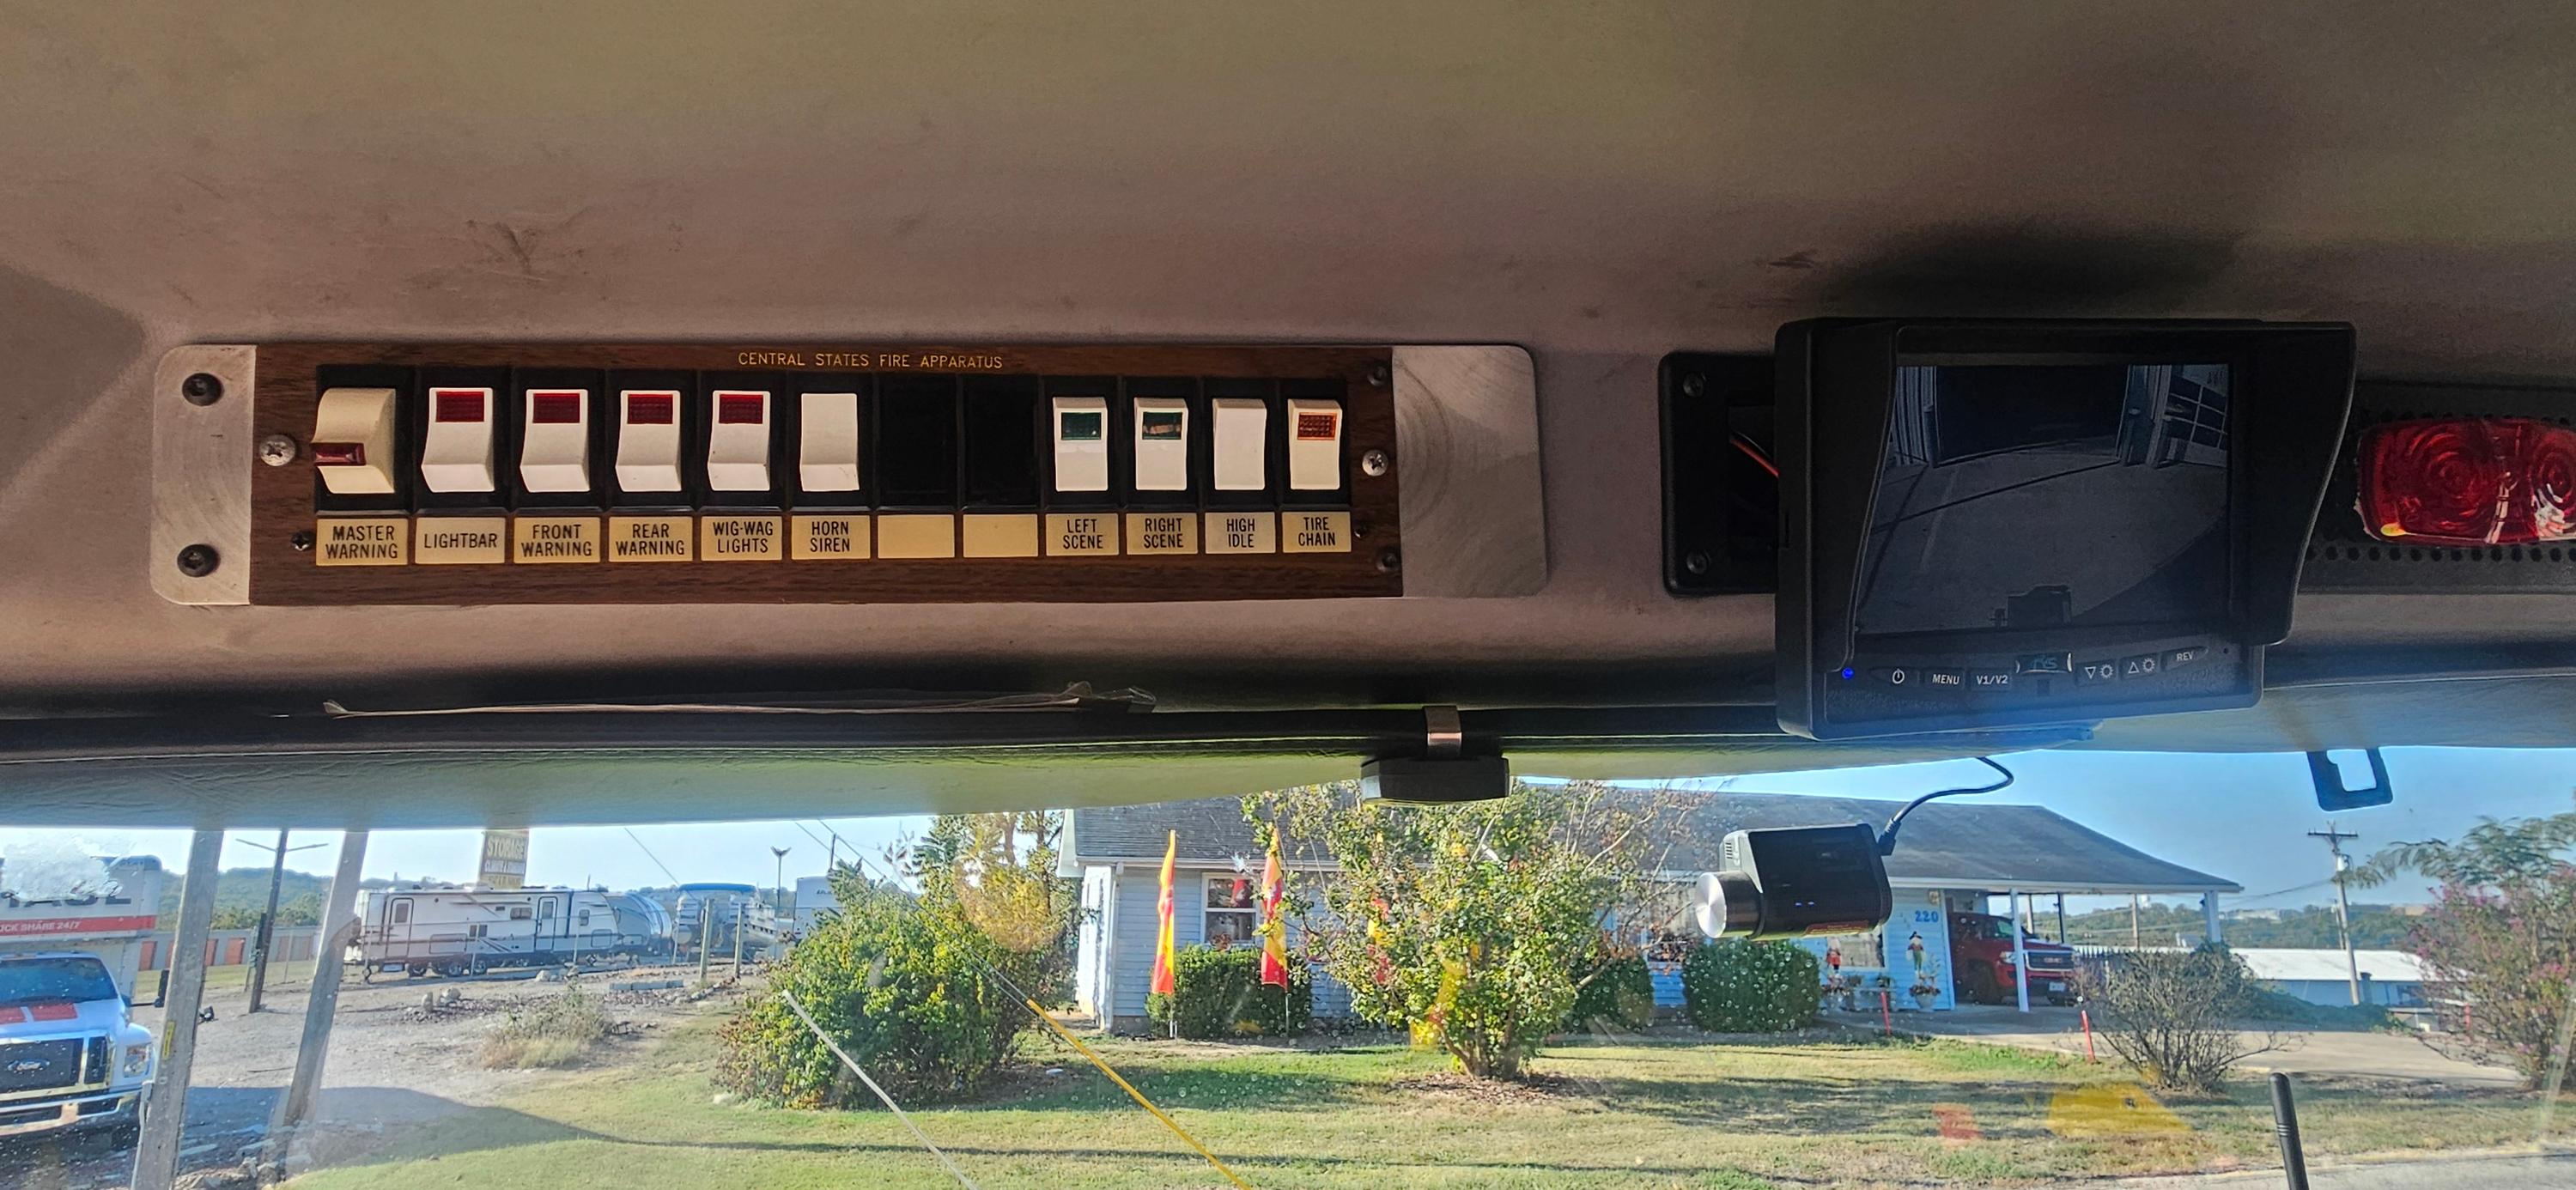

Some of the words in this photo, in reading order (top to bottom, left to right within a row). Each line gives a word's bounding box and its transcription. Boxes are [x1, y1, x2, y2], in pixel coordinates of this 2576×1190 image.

[738, 352, 805, 366] CENTRAL
[816, 354, 869, 367] STATES
[879, 355, 910, 367] FIRE
[920, 355, 1003, 369] APPARATUS
[632, 523, 670, 538] REAR
[713, 521, 774, 537] WIG-WAG
[811, 521, 849, 536] HORN
[1066, 519, 1097, 534] LEFT
[1145, 518, 1182, 532] RIGHT
[1226, 518, 1255, 532] HIGH
[1303, 517, 1330, 531] TIRE
[332, 525, 394, 542] MASTER
[532, 524, 581, 540] FRONT
[1297, 531, 1336, 547] CHAIN
[423, 533, 498, 549] LIGHTBAR
[616, 540, 685, 556] WARNING
[717, 537, 769, 554] LIGHTS
[810, 537, 851, 553] SIREN
[1062, 534, 1103, 549] SCENE
[1143, 533, 1184, 549] SCENE
[1228, 533, 1255, 548] IDLE
[325, 543, 398, 560] WARNING
[520, 541, 592, 557] WARNING
[2176, 650, 2194, 661] REV
[1932, 674, 1959, 684] MENU
[1977, 675, 2008, 685] V1/V2
[487, 836, 525, 859] STORAGE
[1915, 910, 1939, 923] 220
[21, 921, 56, 932] SHARE
[57, 920, 82, 930] 24/7
